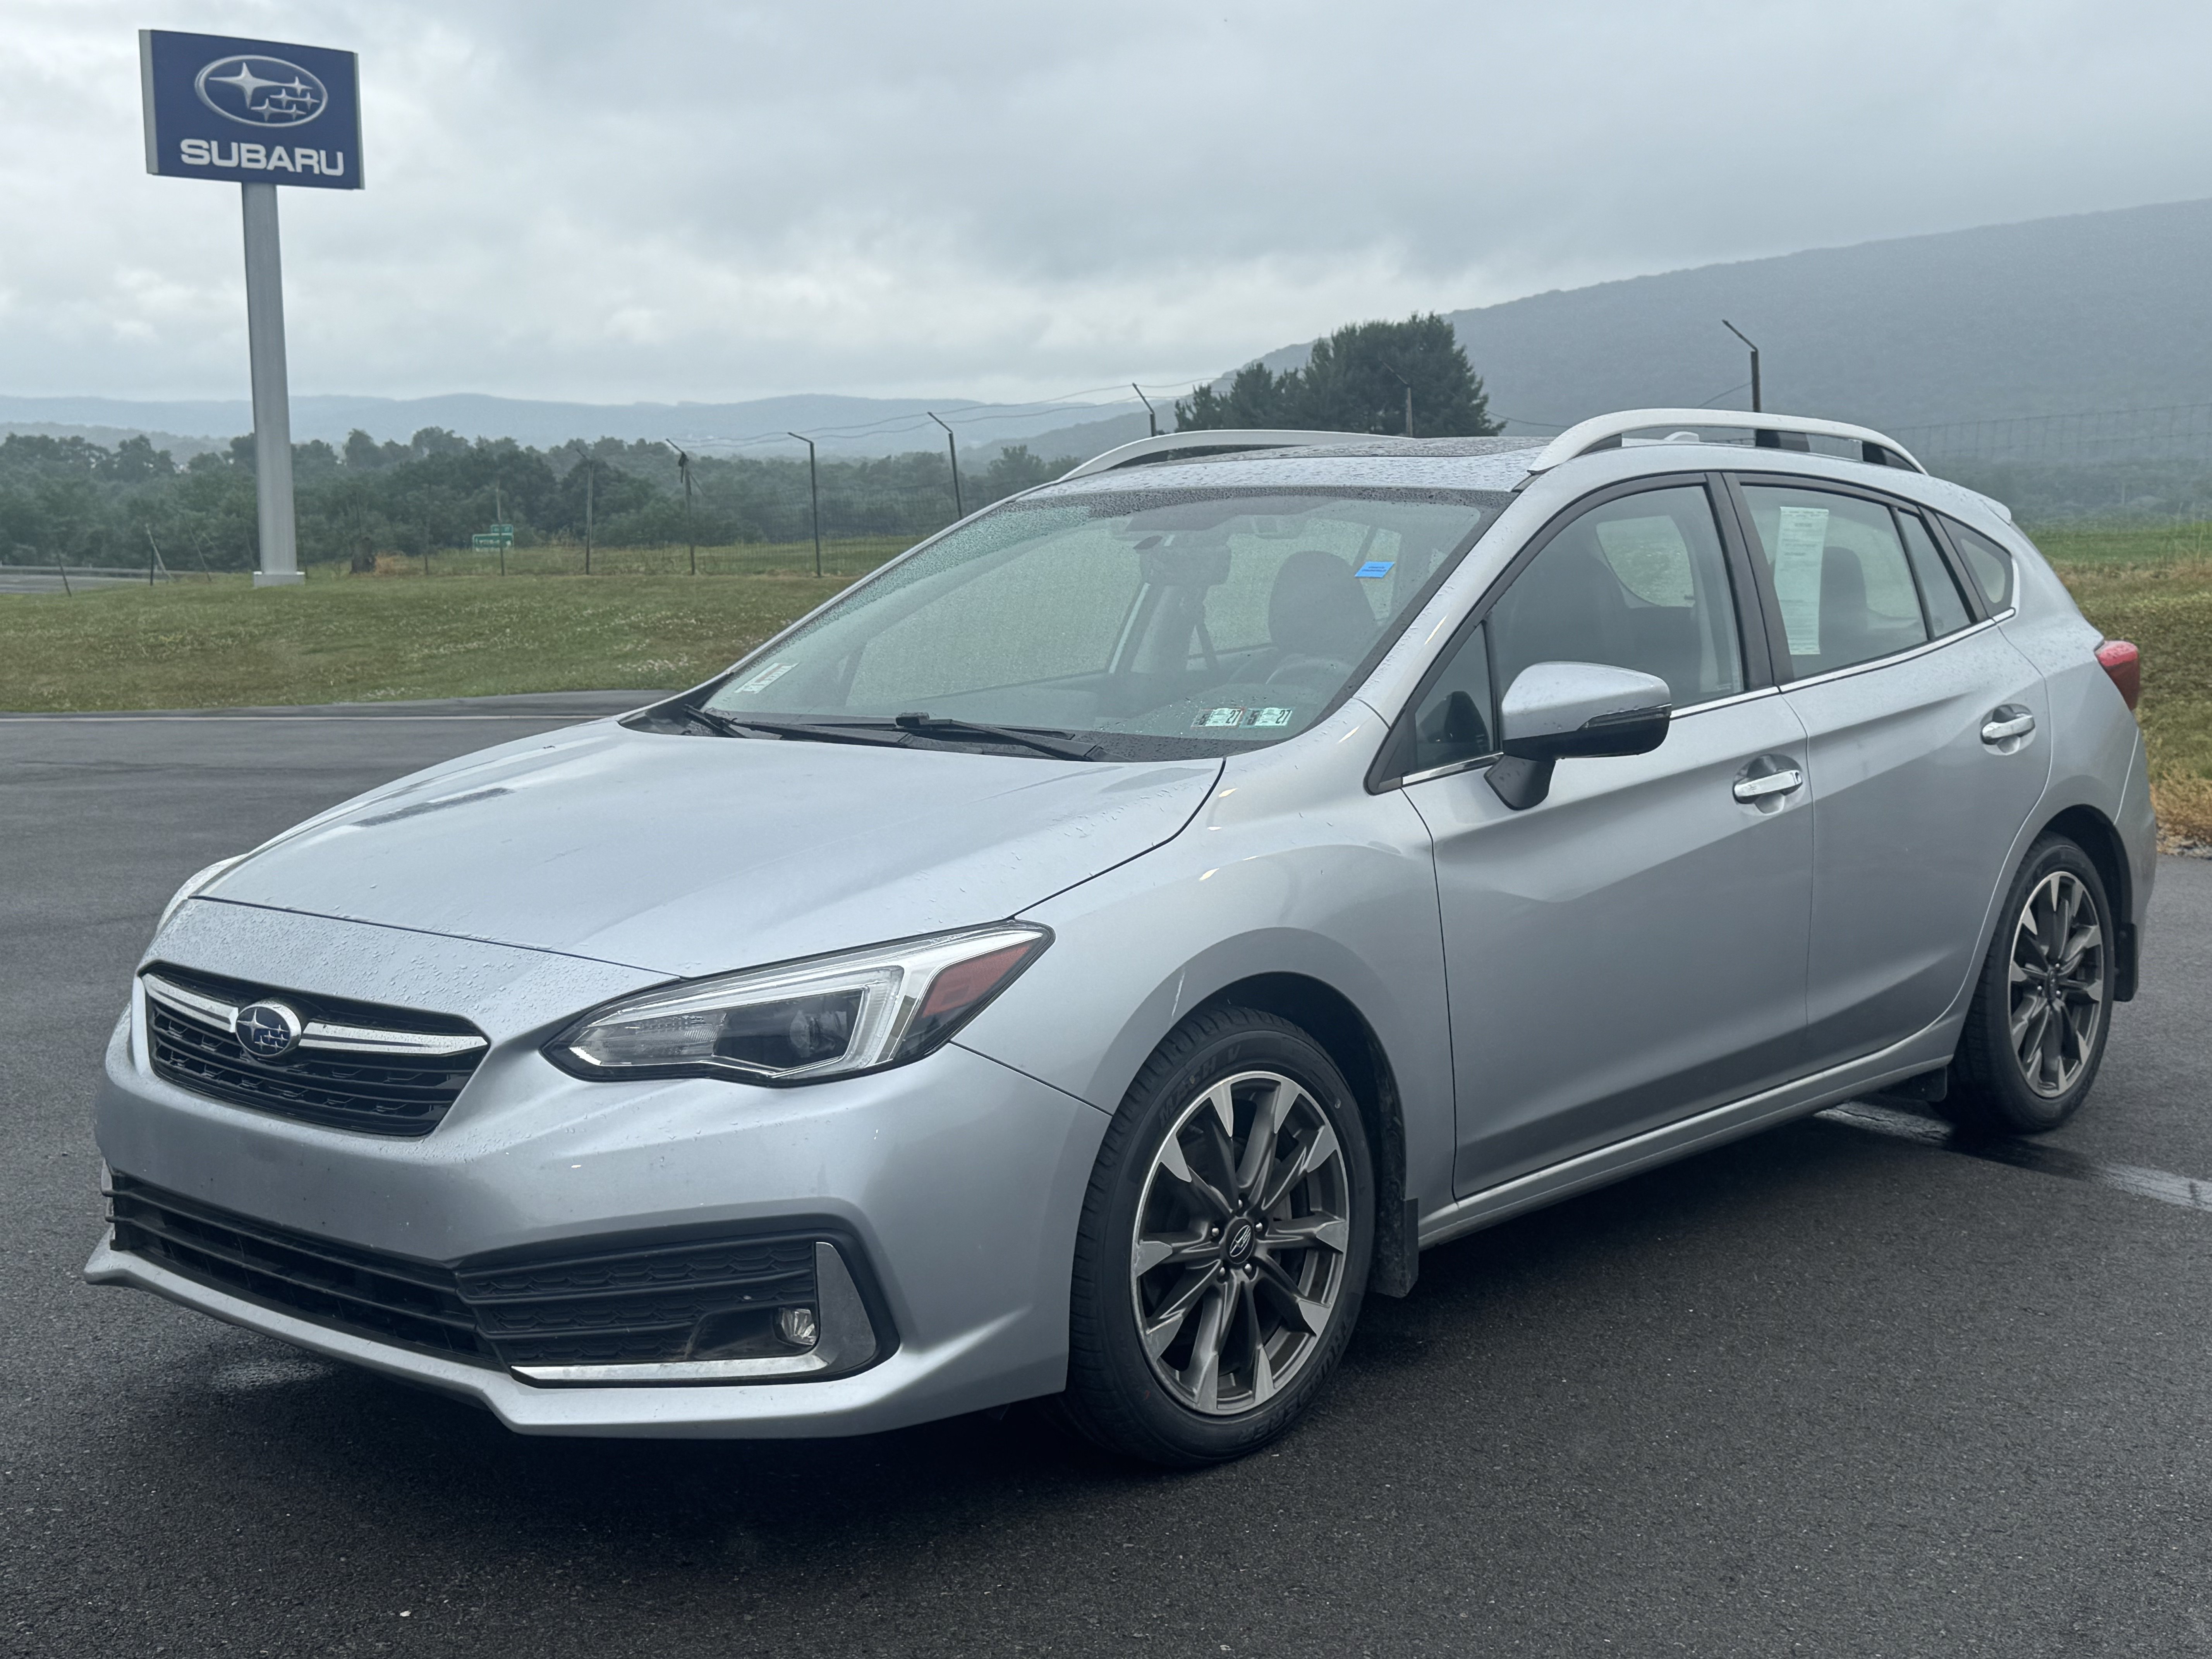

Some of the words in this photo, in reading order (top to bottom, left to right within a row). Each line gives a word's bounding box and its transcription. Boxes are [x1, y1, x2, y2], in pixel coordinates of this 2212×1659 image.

[180, 139, 344, 176] SUBARU
[1225, 710, 1241, 724] 27
[1276, 709, 1291, 724] 27
[1239, 1318, 1351, 1442] THUNDERER
